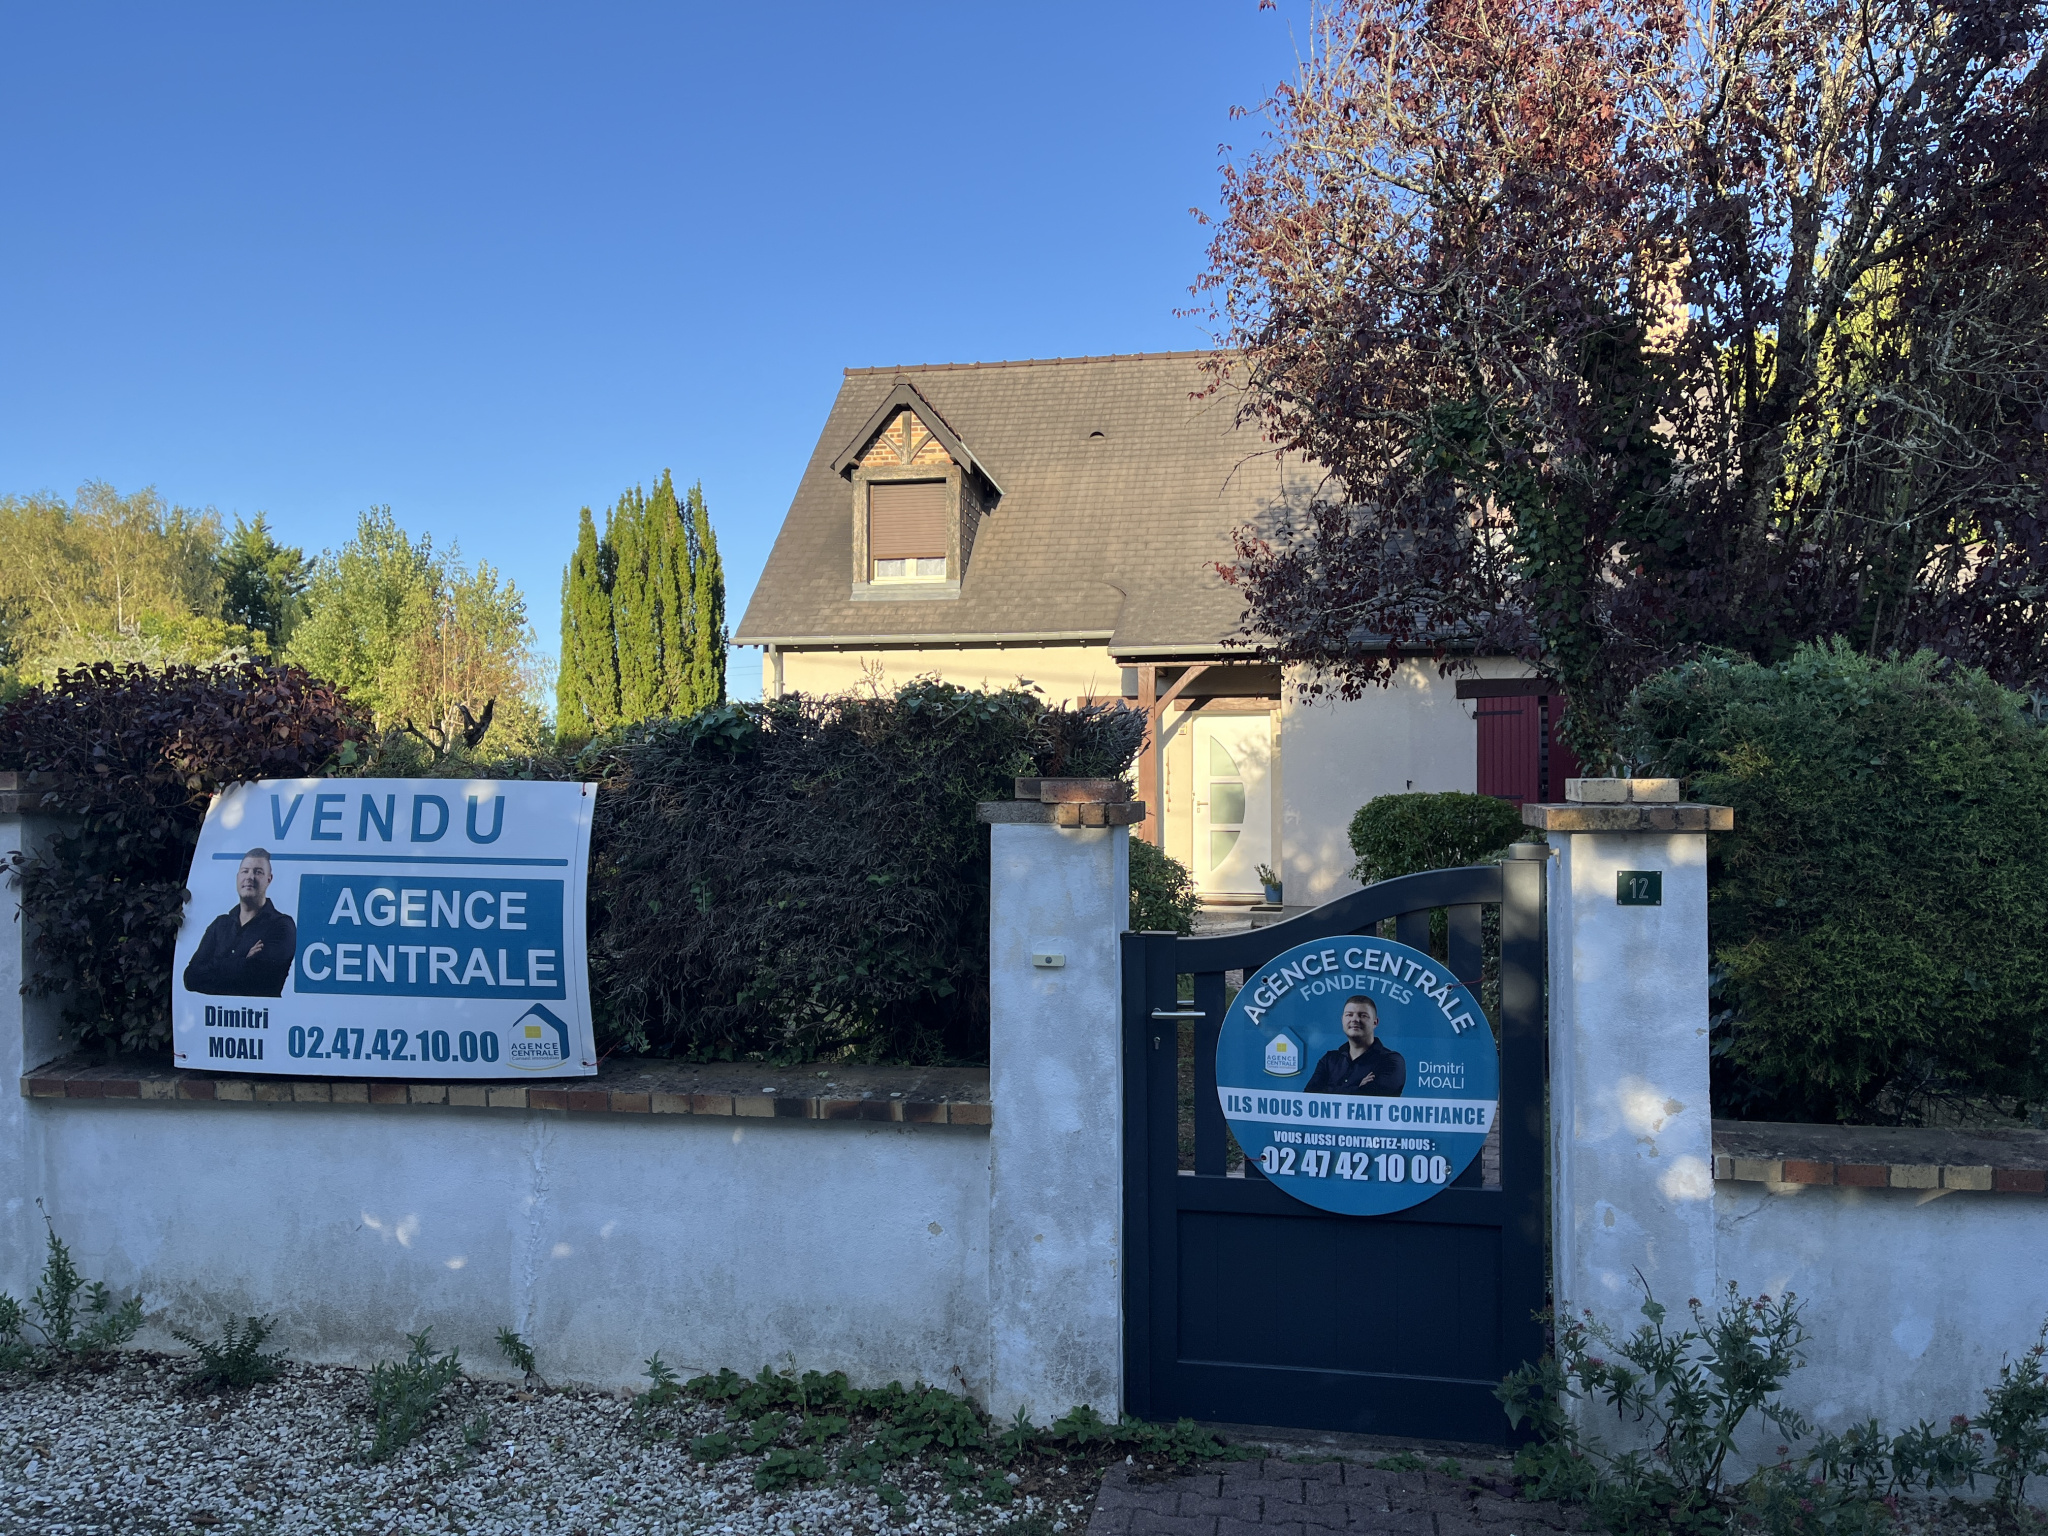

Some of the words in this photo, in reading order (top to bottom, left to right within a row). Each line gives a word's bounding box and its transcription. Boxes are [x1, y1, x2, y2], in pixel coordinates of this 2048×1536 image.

[270, 794, 505, 844] VENDU
[1629, 877, 1649, 899] 12
[328, 887, 528, 930] AGENCE
[302, 942, 557, 987] CENTRALE
[1243, 949, 1339, 1025] AGENCE
[1344, 947, 1476, 1035] CENTRALE
[1300, 974, 1414, 1006] FONDETTES
[204, 1005, 269, 1029] Dimitri
[209, 1037, 263, 1060] MOALI
[288, 1025, 499, 1063] 02.47.42.10.00
[1266, 1054, 1297, 1062] AGENCE
[1418, 1060, 1465, 1075] Dimitri
[1418, 1075, 1465, 1090] MOALI
[1227, 1094, 1253, 1114] ILS
[1257, 1097, 1303, 1117] NOUS
[1308, 1100, 1342, 1120] ONT
[1347, 1104, 1384, 1123] FAIT
[1388, 1104, 1486, 1126] CONFIANCE
[1273, 1130, 1302, 1144] VOUS
[1303, 1132, 1336, 1146] AUSSI
[1262, 1146, 1296, 1176] 02
[1300, 1149, 1331, 1178] 47
[1334, 1151, 1369, 1181] 42
[1374, 1153, 1405, 1183] 10
[1411, 1155, 1447, 1185] 00
